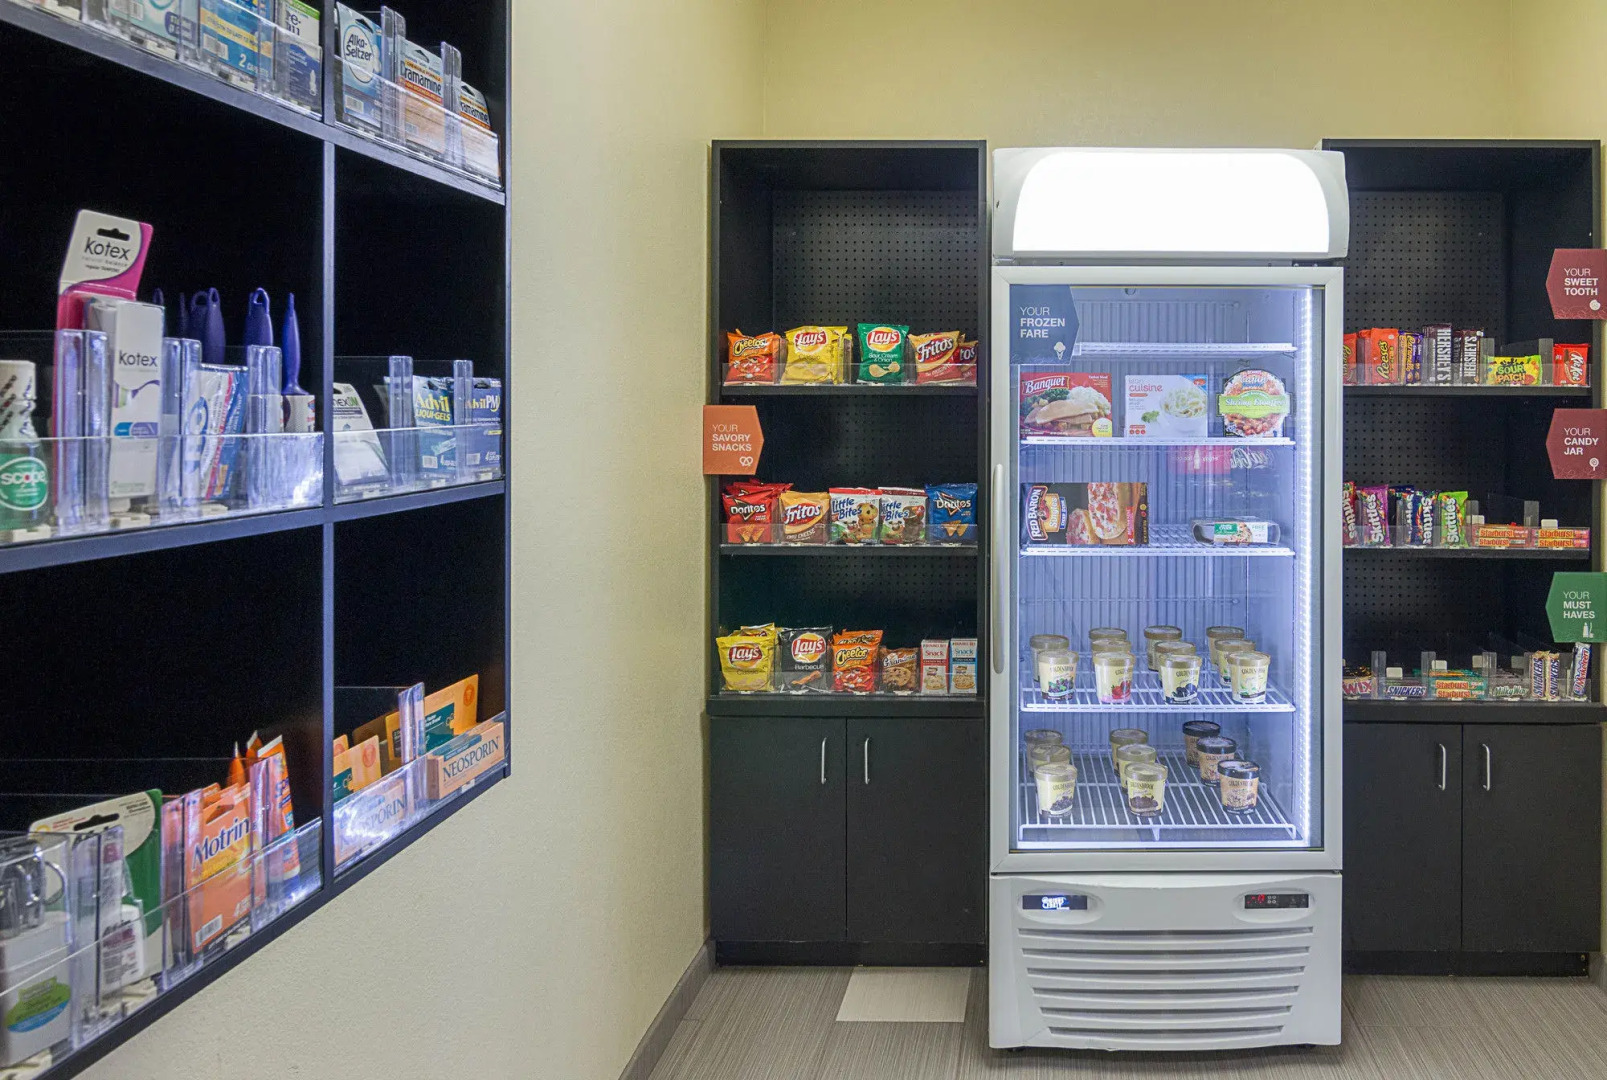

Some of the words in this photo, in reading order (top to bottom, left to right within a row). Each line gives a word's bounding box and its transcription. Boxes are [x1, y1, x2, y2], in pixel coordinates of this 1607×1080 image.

[347, 33, 368, 49] Alka-
[346, 44, 373, 60] Seltzer
[239, 53, 247, 67] 2
[460, 102, 489, 124] ramamine
[1563, 267, 1591, 277] YOUR
[1564, 277, 1599, 286] SWEET
[1563, 287, 1598, 296] TOOTH
[1020, 306, 1050, 316] YOUR
[1020, 317, 1066, 328] FROZEN
[869, 330, 898, 345] Lay's
[1020, 328, 1049, 339] FARE
[917, 337, 953, 362] Fritos
[1497, 365, 1524, 375] SOUR
[1497, 374, 1526, 383] PATCH
[1025, 376, 1065, 394] Banquet
[1128, 384, 1163, 392] cuisine
[414, 393, 450, 413] Advil
[415, 408, 451, 422] LIQUI-GELS
[712, 423, 739, 433] YOUR
[1563, 427, 1591, 436] YOUR
[712, 433, 751, 442] SAVORY
[1564, 437, 1599, 446] CANDY
[712, 443, 752, 452] SNACKS
[1563, 447, 1584, 456] JAR
[730, 503, 767, 514] Doritos
[1027, 489, 1042, 519] BARON
[784, 504, 822, 525] Fritos
[838, 508, 862, 519] Bites
[886, 510, 908, 521] Bites
[1049, 497, 1058, 528] Singles
[1367, 493, 1385, 543] Skittles
[1421, 496, 1433, 544] Skittles
[1445, 497, 1460, 543] Skittles
[1031, 518, 1042, 538] RED
[1480, 528, 1514, 537] Starburst
[1540, 530, 1573, 538] Starburst
[1480, 538, 1509, 546] Starburst
[1539, 540, 1573, 548] Starburst
[1563, 590, 1590, 600] YOUR
[1563, 601, 1591, 609] MUST
[1563, 610, 1596, 619] HAVES
[793, 637, 824, 655] Lay's
[836, 646, 867, 667] Cheetos
[1533, 658, 1543, 697] SNICKERS
[1550, 659, 1559, 698] SNICKERS
[1342, 681, 1372, 695] WIX
[1386, 686, 1427, 697] SNICKERS
[1436, 682, 1469, 690] Starburst
[443, 736, 499, 782] NEOSPORIN
[191, 817, 250, 872] Motrin
